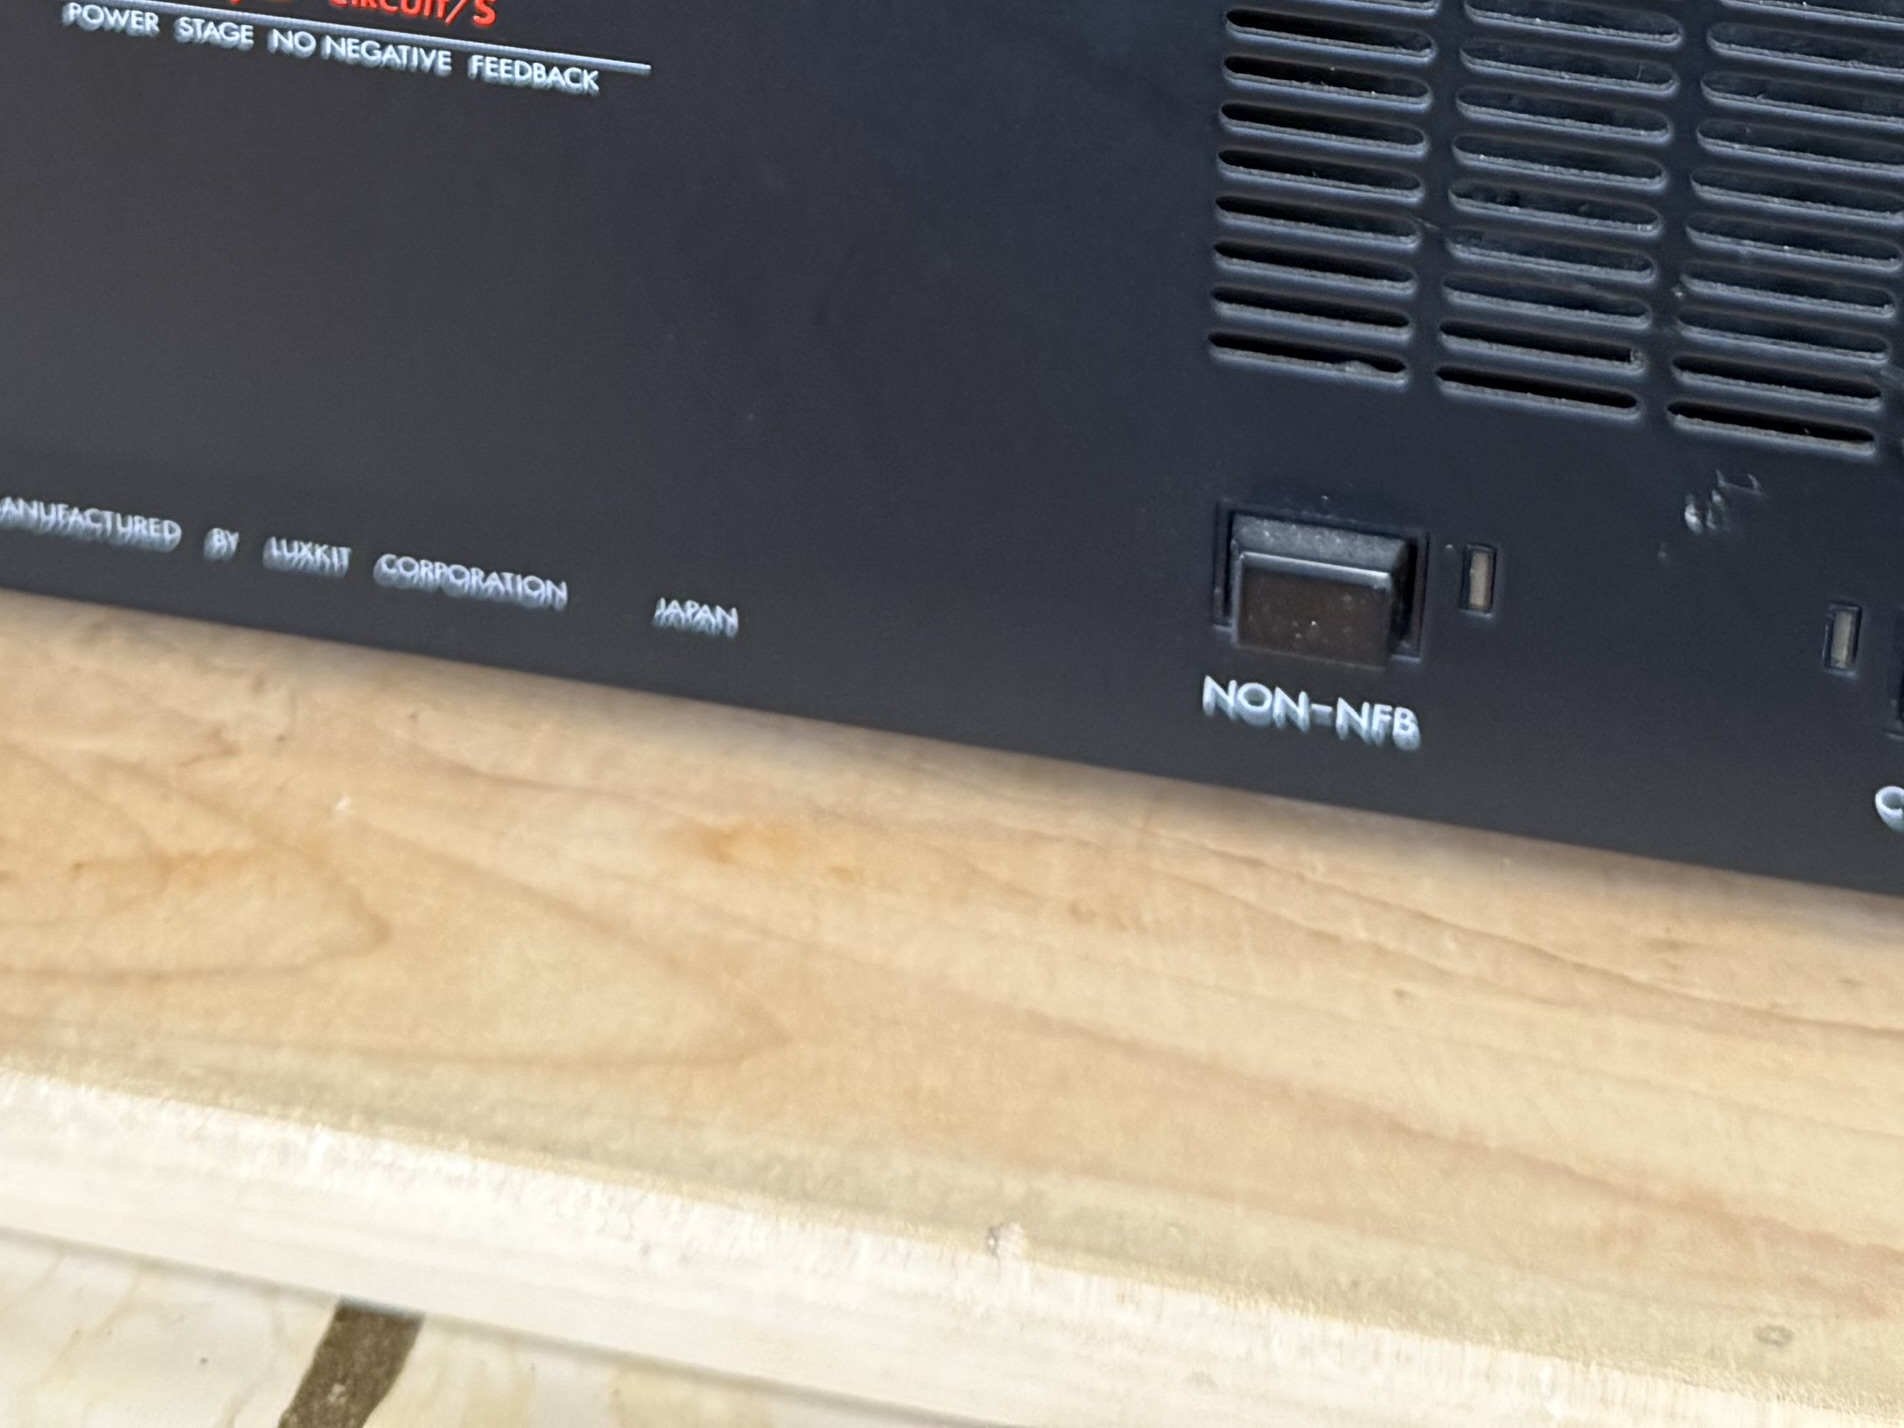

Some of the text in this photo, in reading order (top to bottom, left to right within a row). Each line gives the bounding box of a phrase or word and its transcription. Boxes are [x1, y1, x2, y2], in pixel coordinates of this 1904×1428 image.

[62, 1, 600, 96] POWER STAGE NO NEGATIVE FEEDBACK
[202, 527, 240, 563] BY
[262, 535, 351, 578] LUXKIT
[373, 553, 569, 611] CORPORATION
[652, 597, 739, 639] JAPAN
[1202, 674, 1422, 751] NON-NFB
